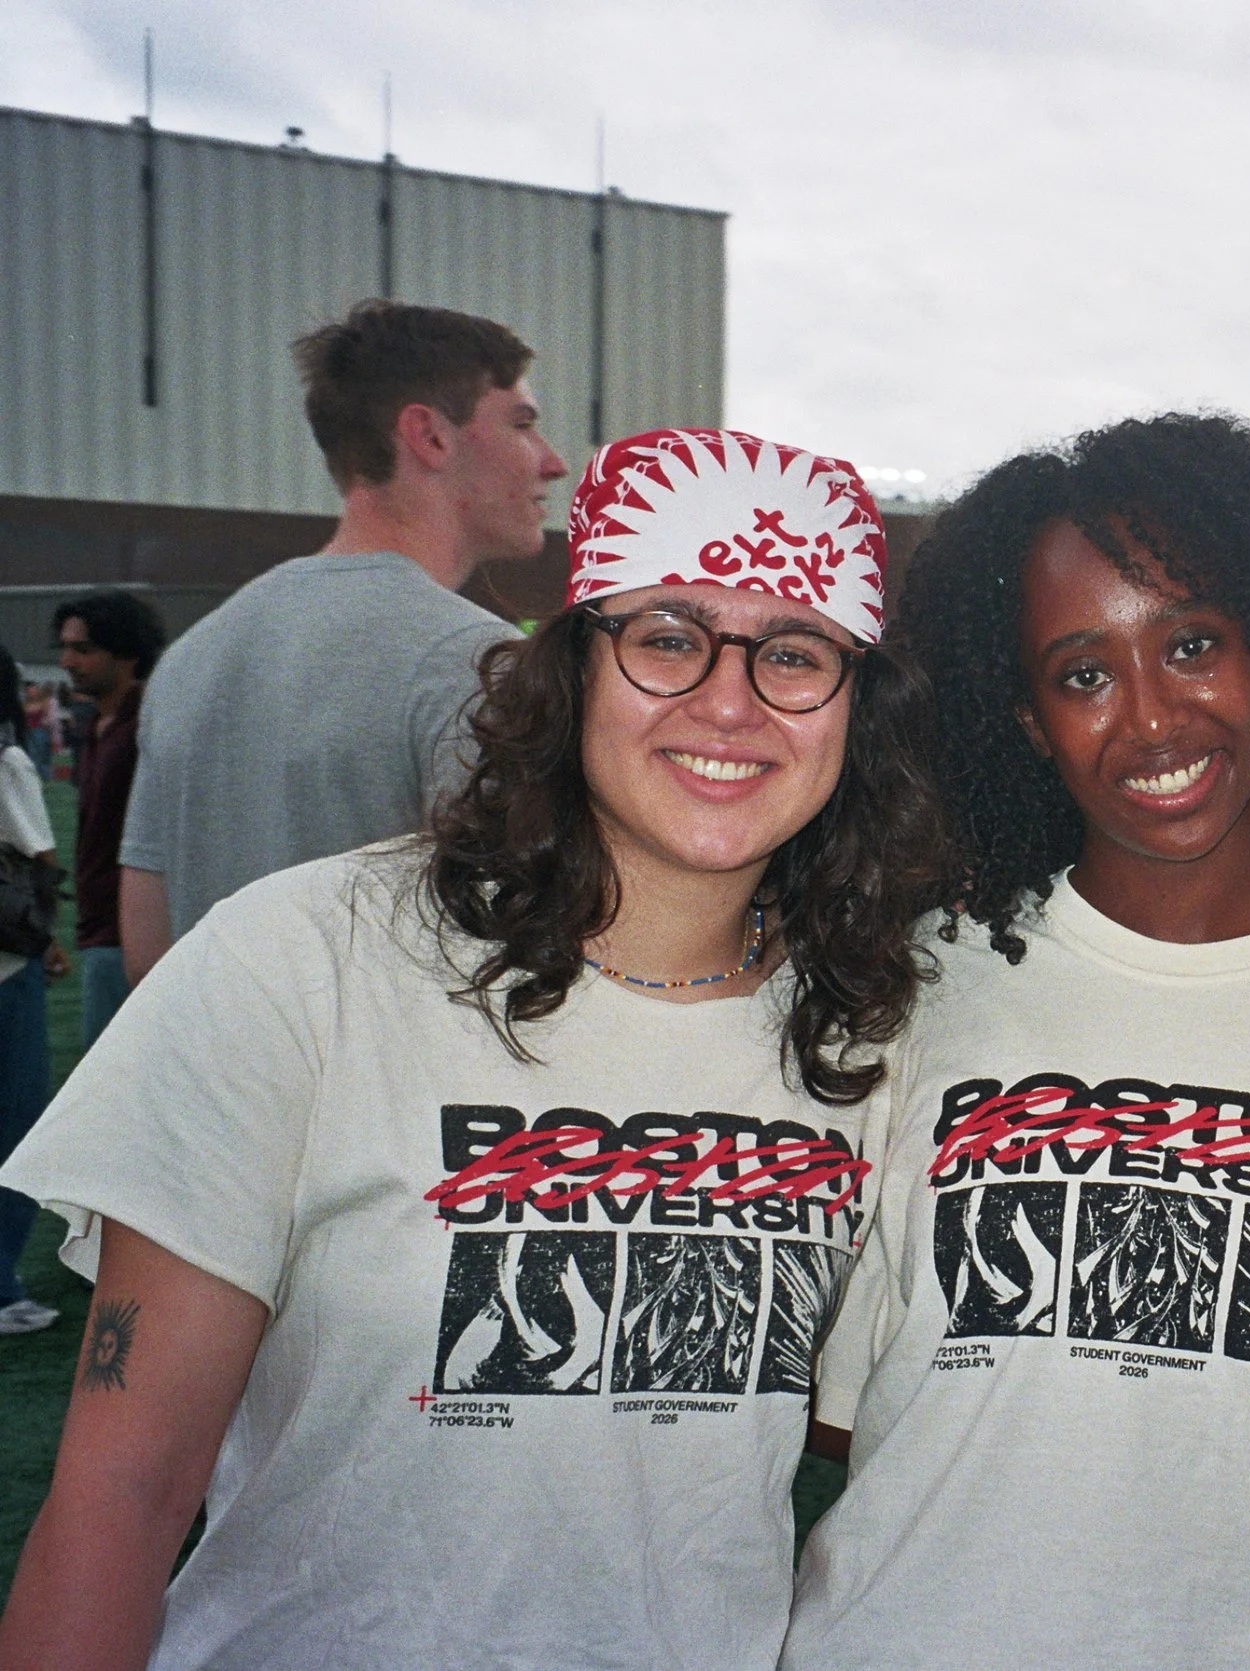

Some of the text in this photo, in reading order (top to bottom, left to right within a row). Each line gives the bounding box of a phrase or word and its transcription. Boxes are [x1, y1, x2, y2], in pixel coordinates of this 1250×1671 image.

[440, 1104, 864, 1203] BOSTON
[437, 1181, 865, 1247] UNIVERSITY
[1070, 1346, 1207, 1371] STUDENT GOVERNMENT
[1118, 1365, 1149, 1379] 2026
[612, 1399, 739, 1413] STUDENT GOVERNMENT
[650, 1413, 679, 1425] 2026
